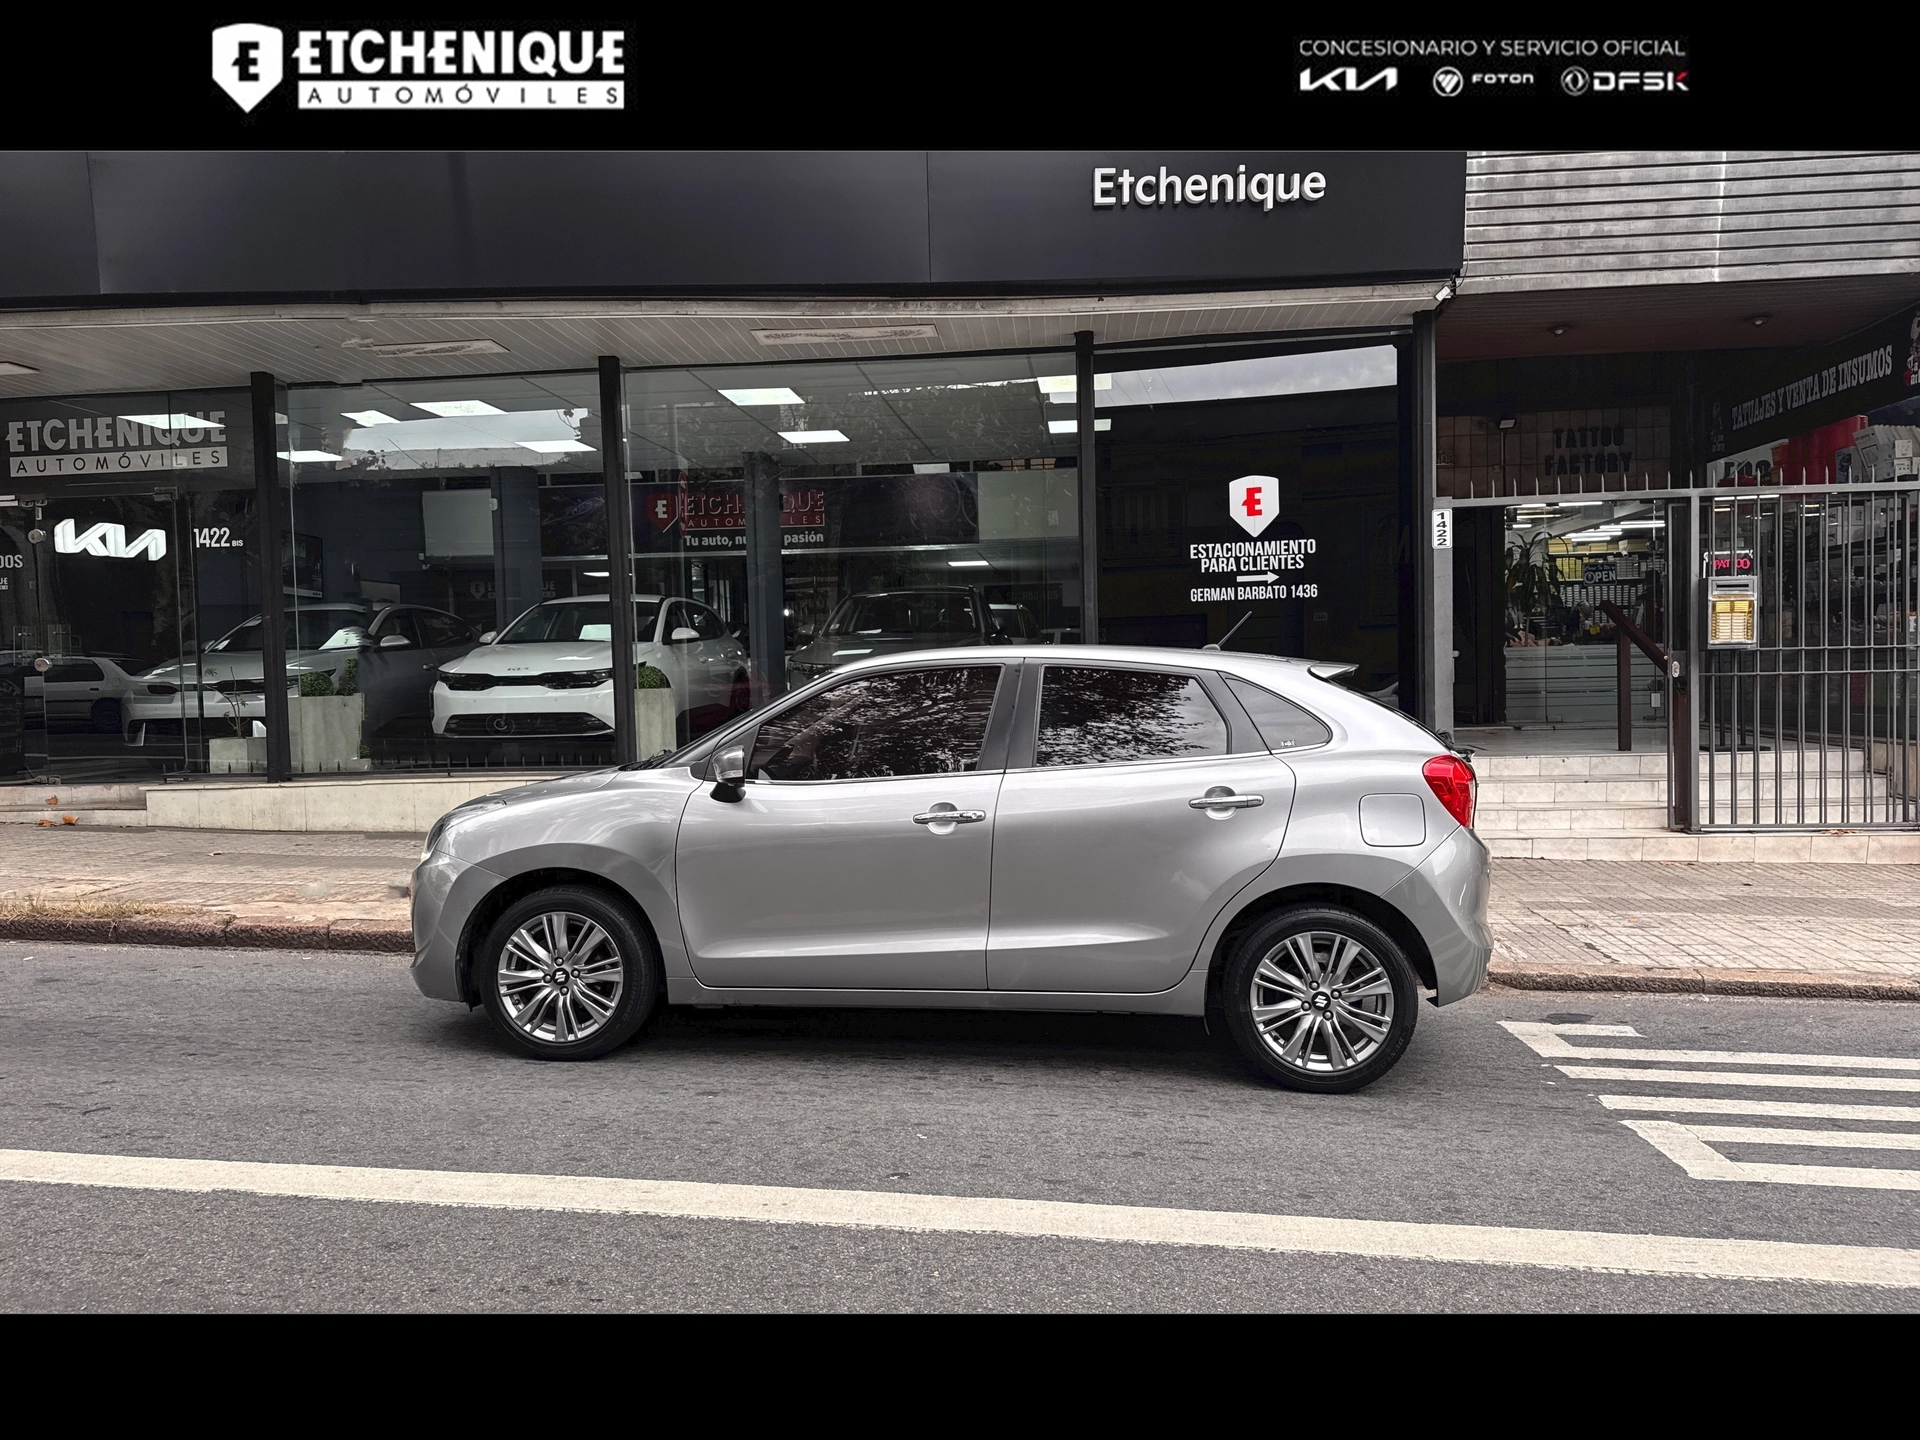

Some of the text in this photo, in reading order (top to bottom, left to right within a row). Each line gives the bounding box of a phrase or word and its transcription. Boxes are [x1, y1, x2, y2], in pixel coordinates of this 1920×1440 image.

[1093, 164, 1326, 212] Etchenique
[1731, 392, 1776, 431] TATUAJES
[1776, 387, 1785, 414] Y
[1785, 373, 1820, 410] VENTA
[1821, 365, 1837, 397] DE
[1838, 345, 1893, 392] INSUMOS
[1553, 427, 1625, 449] TATTOO
[16, 450, 220, 474] AUTOMÓVILES
[1544, 452, 1632, 476] FACTORY
[684, 490, 825, 516] ETCHQUE
[688, 515, 821, 527] AUTOMLES
[1436, 511, 1448, 547] 1422
[54, 518, 167, 561] KIA
[193, 527, 244, 548] 1422 BIS
[685, 535, 699, 547] Tu
[701, 536, 733, 548] auto,
[784, 531, 824, 546] pasión
[1190, 539, 1316, 559] ESTACIONAMIENTO
[1201, 554, 1305, 573] PARA CLIENTES
[1584, 570, 1616, 584] OPEN
[1190, 584, 1318, 602] GERMAN BARBATO 1436
